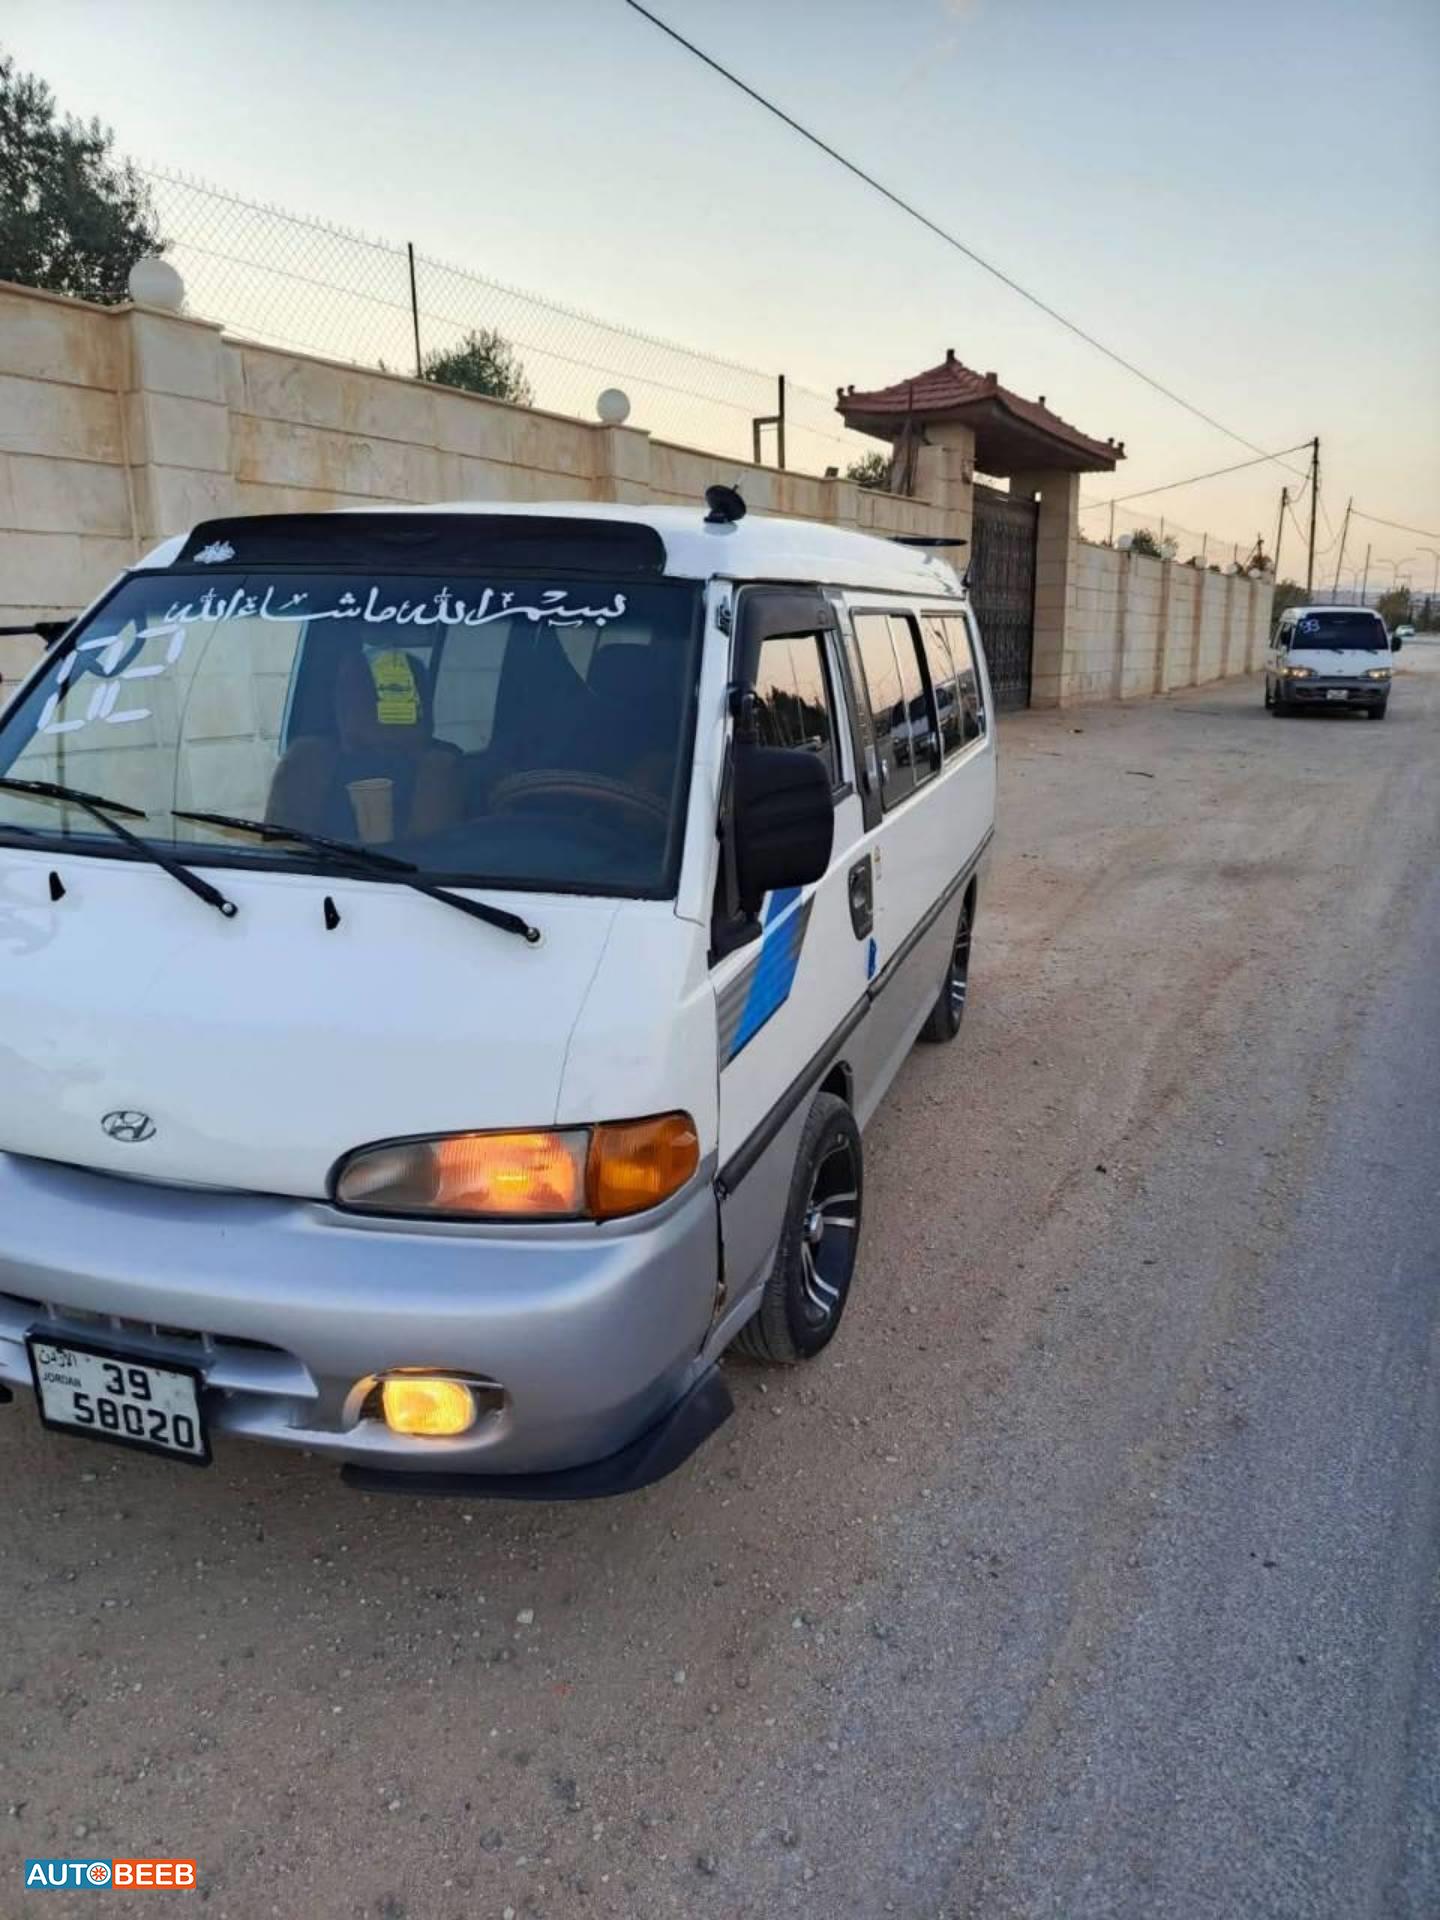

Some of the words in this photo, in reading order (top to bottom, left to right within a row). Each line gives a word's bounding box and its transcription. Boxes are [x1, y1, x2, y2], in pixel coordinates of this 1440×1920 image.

[43, 1372, 82, 1388] JORDAN
[102, 1363, 152, 1401] 39
[73, 1391, 194, 1449] 58020
